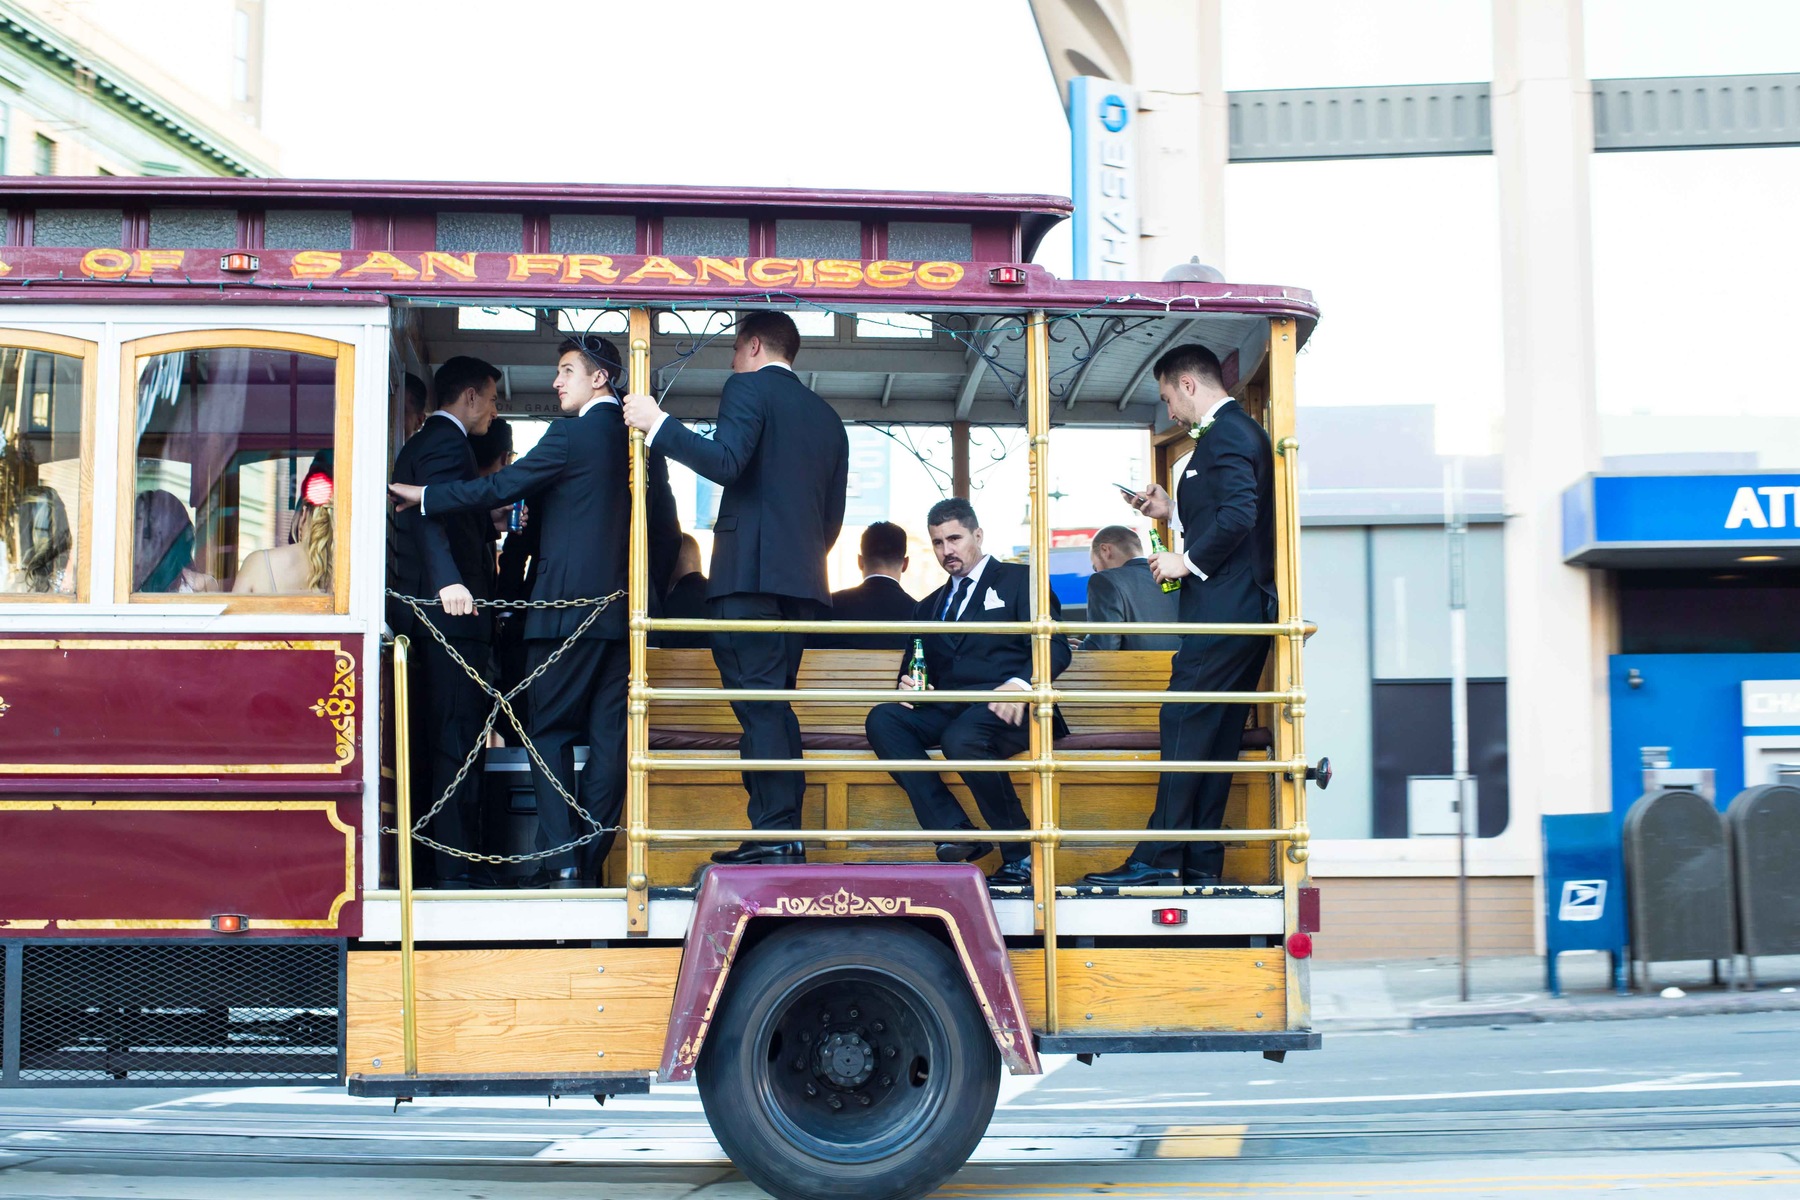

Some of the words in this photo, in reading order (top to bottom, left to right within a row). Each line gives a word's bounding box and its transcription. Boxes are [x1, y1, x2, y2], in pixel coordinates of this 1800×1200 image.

[80, 248, 185, 278] OF
[289, 250, 479, 282] SAN
[506, 253, 965, 290] FRANCISCO
[1724, 486, 1800, 529] AT
